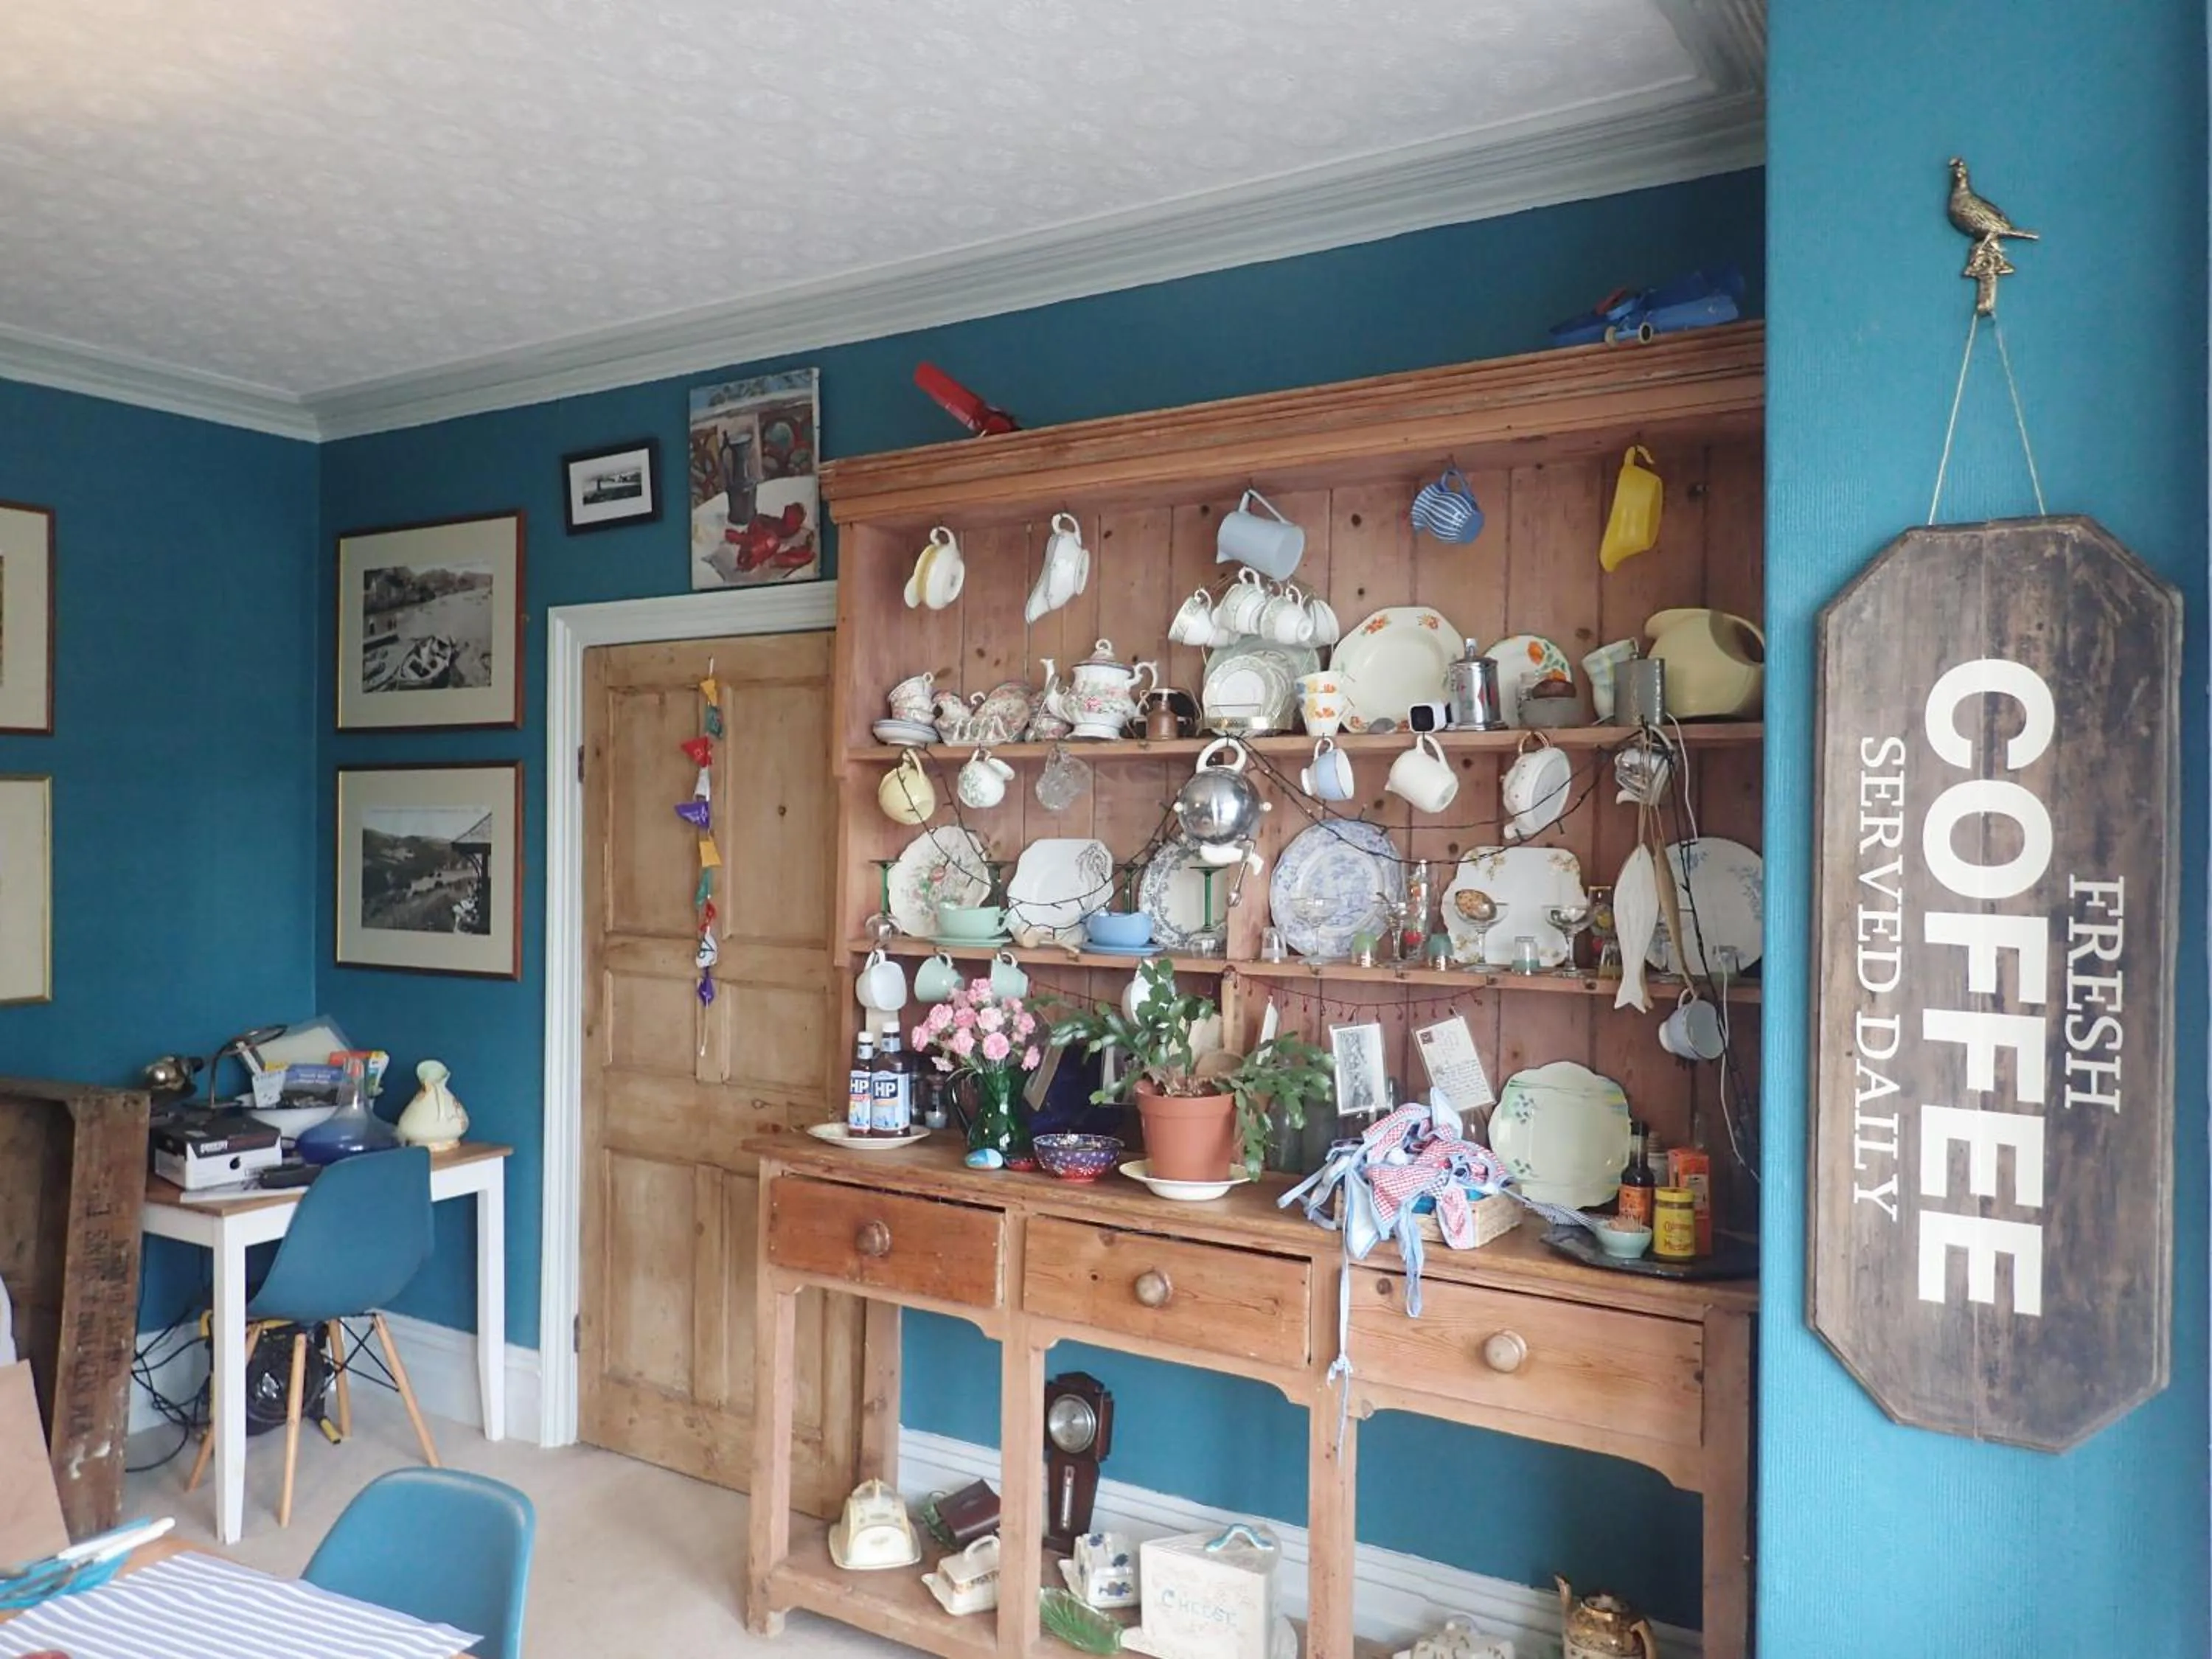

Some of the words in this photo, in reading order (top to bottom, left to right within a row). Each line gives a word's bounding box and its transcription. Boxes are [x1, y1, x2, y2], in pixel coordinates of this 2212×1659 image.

[1857, 737, 1906, 993] SERVED
[850, 1079, 869, 1093] HP
[875, 1082, 896, 1098] HP
[1919, 658, 2055, 1317] COFFEE
[2064, 873, 2124, 1114] FRESH
[1854, 1011, 1901, 1222] DAILY
